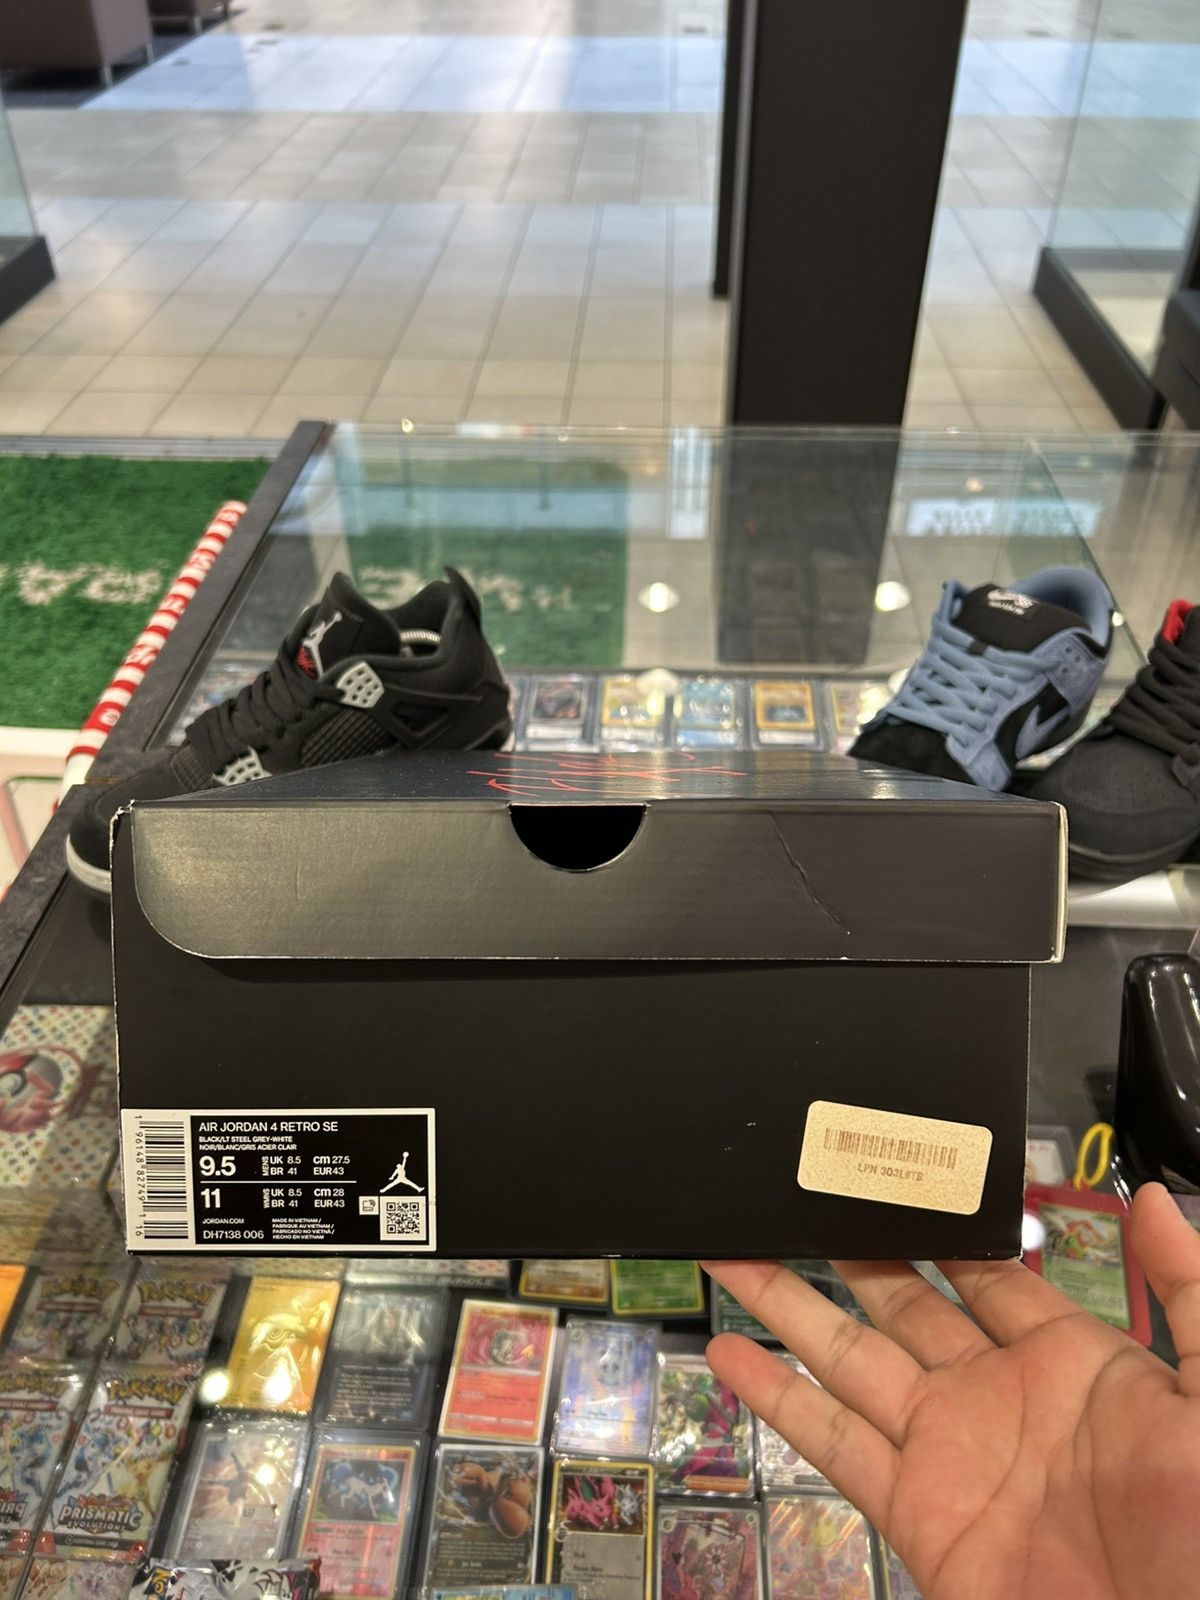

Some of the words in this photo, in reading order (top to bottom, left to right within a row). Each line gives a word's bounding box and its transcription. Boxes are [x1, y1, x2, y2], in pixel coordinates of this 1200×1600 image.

[199, 1122, 218, 1132] AIR
[220, 1122, 268, 1132] JORDAN
[270, 1122, 278, 1132] 4
[280, 1121, 321, 1132] RETRO
[322, 1121, 339, 1132] SE
[135, 1131, 145, 1164] 96148
[199, 1155, 237, 1176] 9.5
[270, 1155, 284, 1164] UK
[287, 1155, 302, 1165] 8.5
[313, 1156, 331, 1164] cm
[332, 1156, 351, 1164] 27.5
[261, 1156, 269, 1176] MENS
[270, 1167, 284, 1175] BR
[287, 1167, 298, 1175] 41
[857, 1163, 877, 1174] LPN
[136, 1169, 146, 1202] 82749
[200, 1188, 221, 1208] 11
[271, 1188, 285, 1197] UK
[288, 1188, 303, 1197] 8.5
[313, 1188, 332, 1197] cm
[333, 1188, 345, 1197] 28
[271, 1199, 285, 1208] BR
[288, 1199, 299, 1207] 41
[203, 1230, 241, 1240] DH7138
[243, 1230, 265, 1239] 006
[59, 1504, 143, 1529] PRISMATIC
